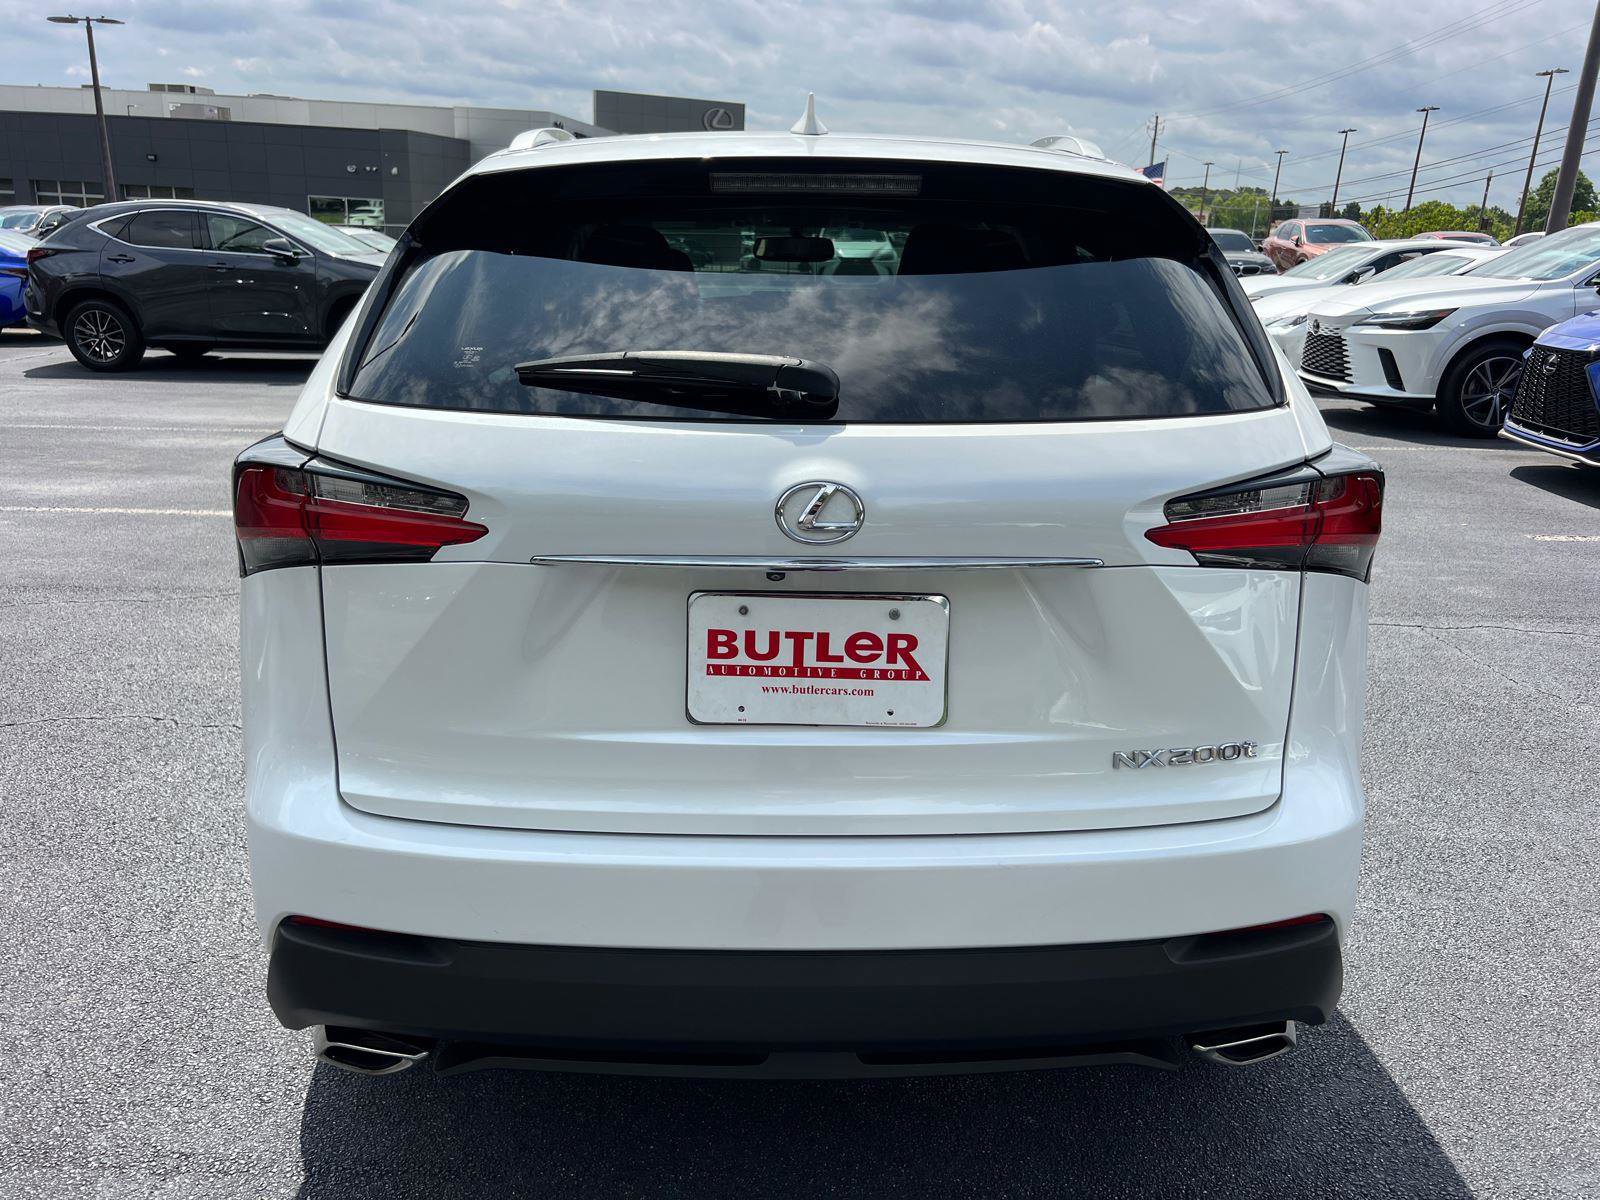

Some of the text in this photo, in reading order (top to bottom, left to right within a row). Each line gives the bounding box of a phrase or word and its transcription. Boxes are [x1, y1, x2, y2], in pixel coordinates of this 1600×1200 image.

[707, 665, 923, 681] AUTOMOTIVE GROUP
[761, 684, 875, 697] www.butlercars.com
[1112, 740, 1258, 769] NX200t
